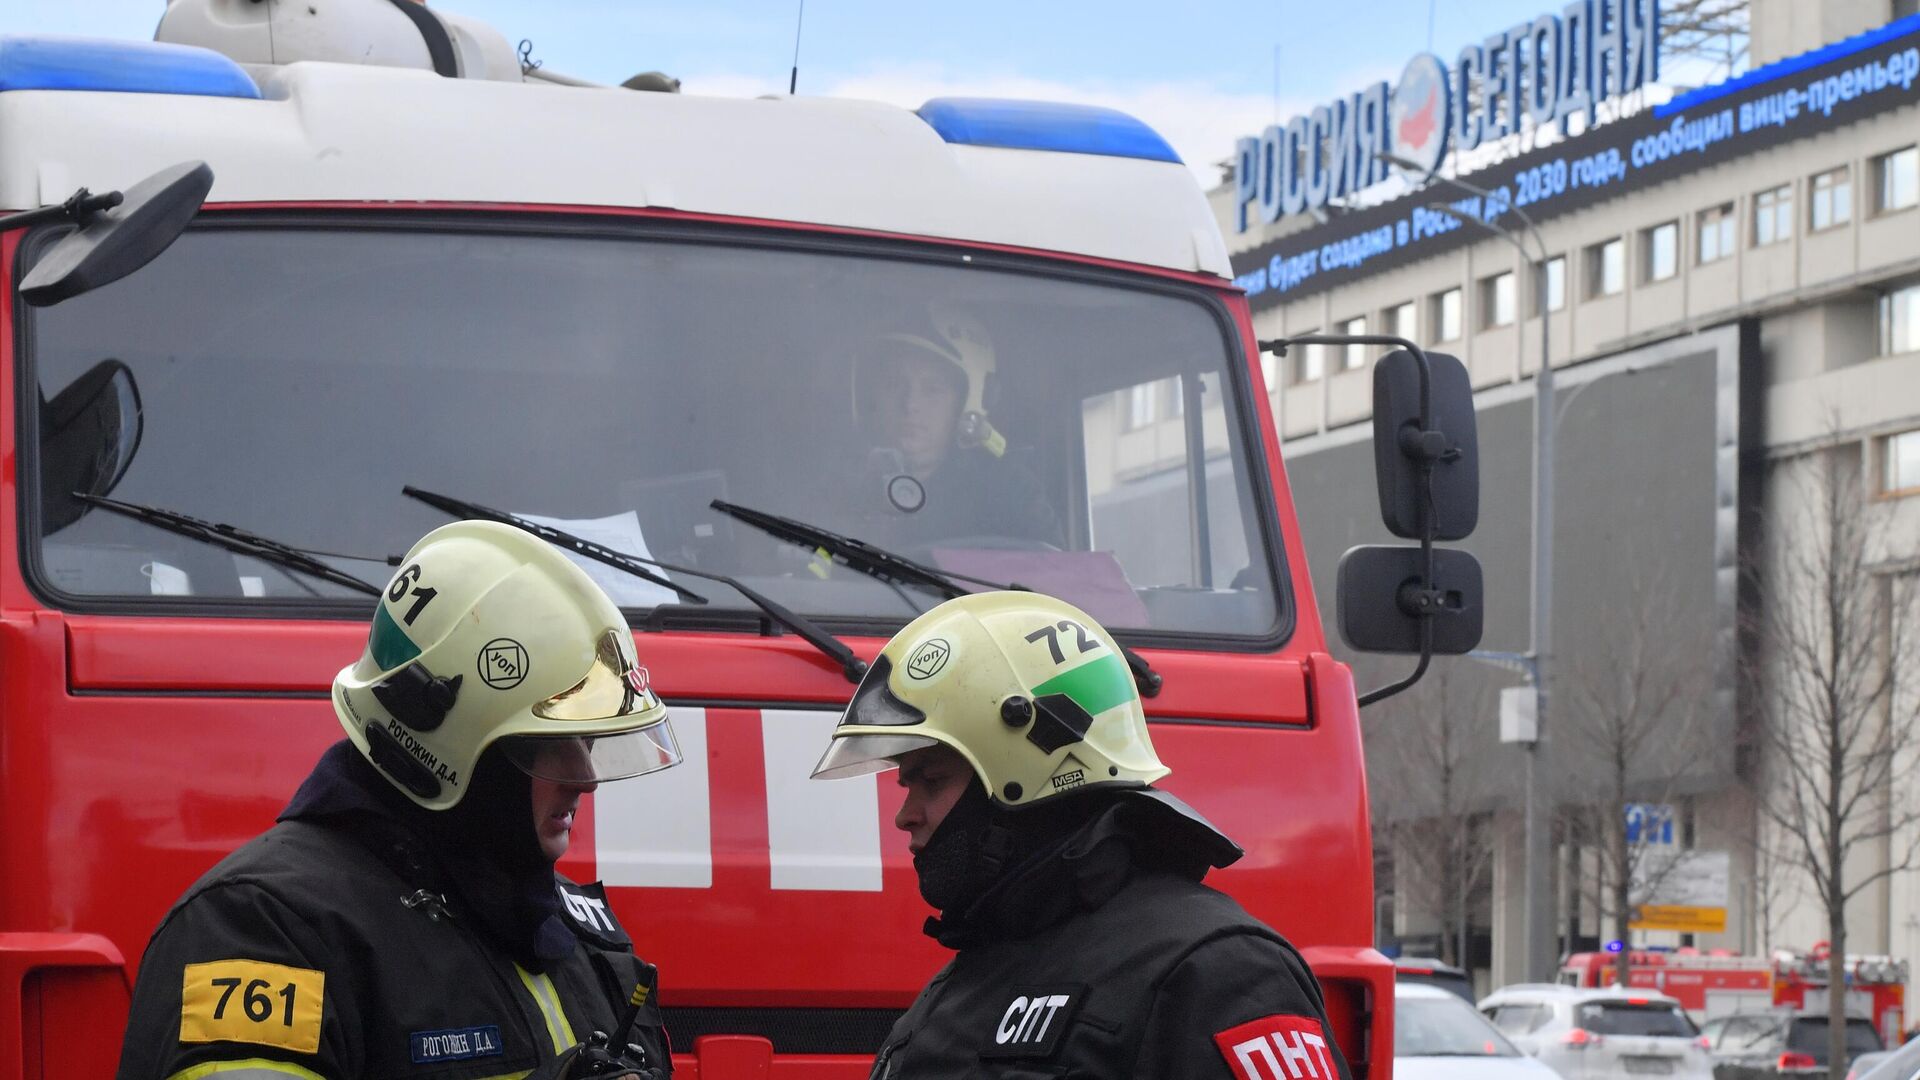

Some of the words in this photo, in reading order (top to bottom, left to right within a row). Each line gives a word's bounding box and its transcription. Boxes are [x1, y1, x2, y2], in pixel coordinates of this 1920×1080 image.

[1234, 81, 1389, 233] РОССИЯ
[1454, 0, 1659, 150] СЕГОДНЯ
[1269, 254, 1318, 292] будет
[1320, 224, 1393, 271] создана
[1396, 219, 1409, 247] в
[1515, 158, 1567, 207] 2030
[1571, 147, 1626, 189] года,
[1631, 108, 1734, 168] сообщил
[1739, 47, 1920, 132] вице-премьер
[388, 563, 438, 627] 61
[490, 651, 517, 677] УОП
[1024, 619, 1101, 666] 72
[388, 718, 438, 769] РОГОЖИН
[435, 763, 459, 787] Д.А.
[1053, 770, 1083, 787] MSA
[210, 976, 298, 1028] 761
[995, 994, 1070, 1046] СПТ
[422, 1033, 471, 1057] РОГОЖИН
[473, 1031, 496, 1054] Д.А.
[1231, 1029, 1333, 1080] ПНТ
